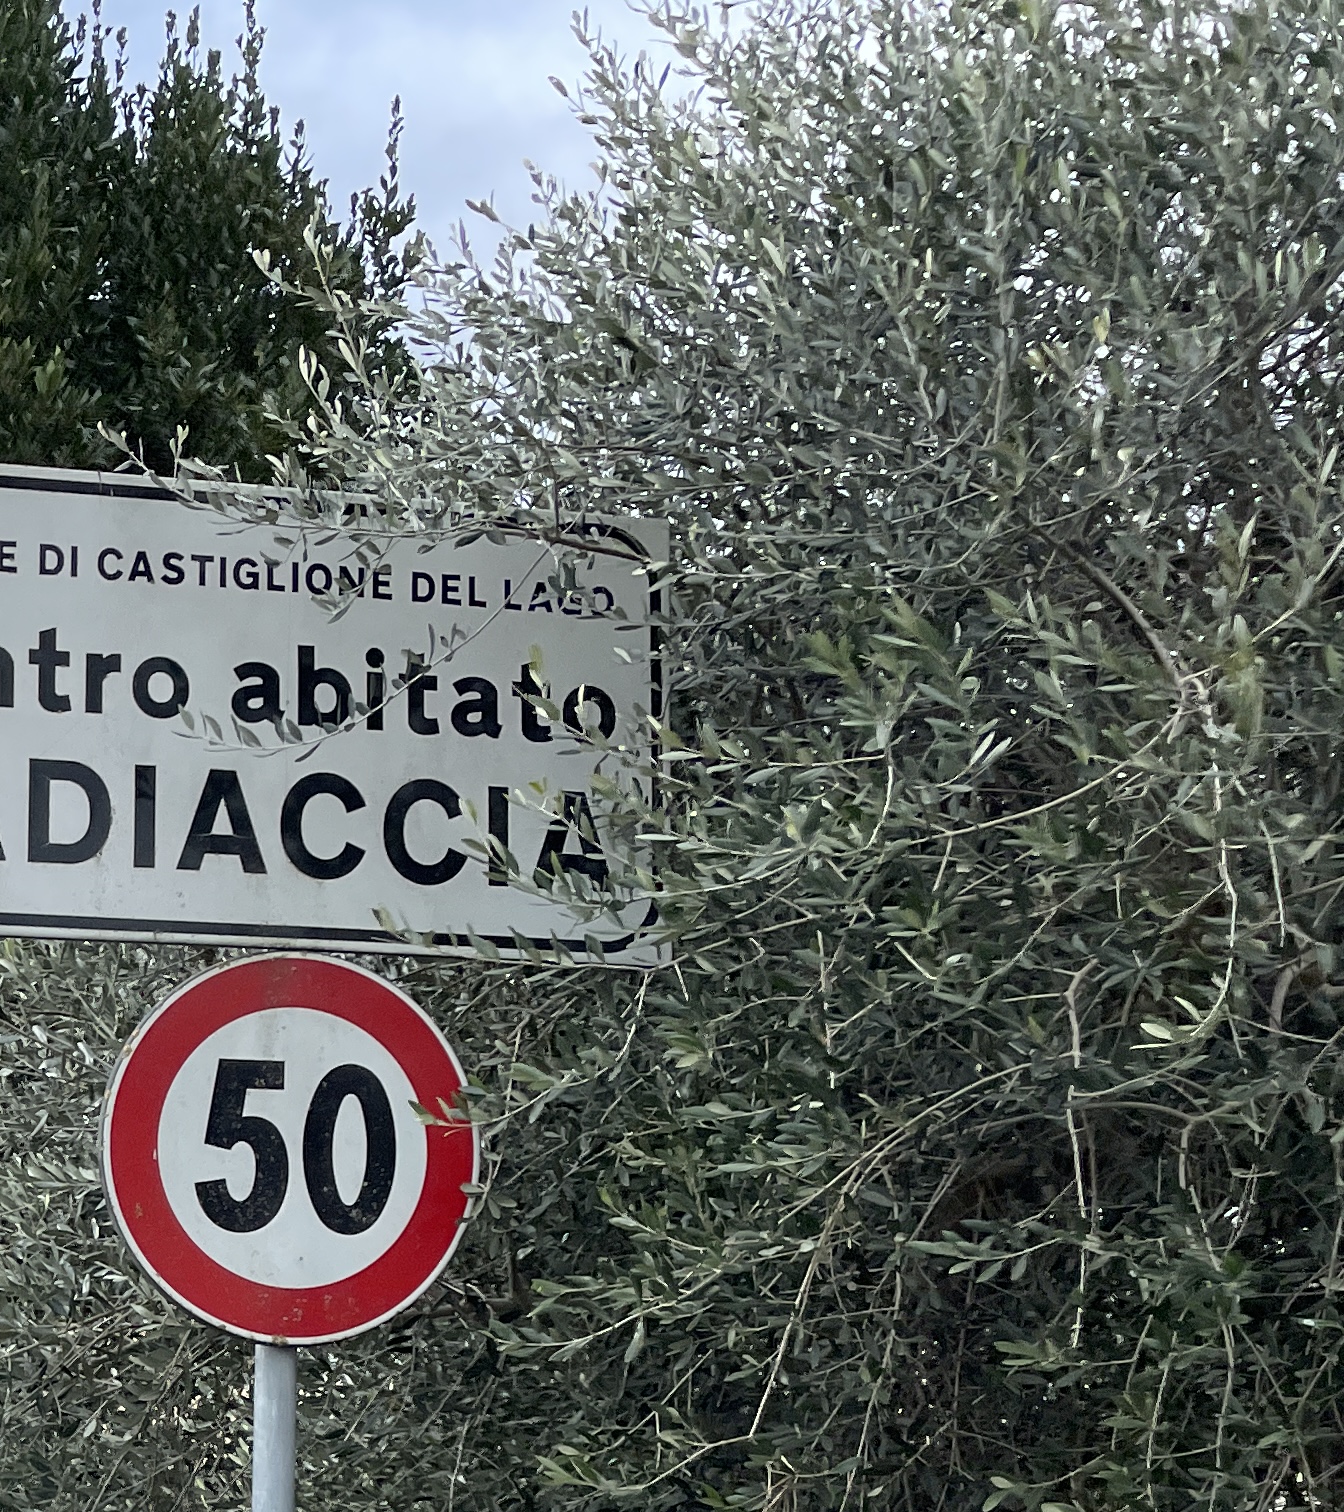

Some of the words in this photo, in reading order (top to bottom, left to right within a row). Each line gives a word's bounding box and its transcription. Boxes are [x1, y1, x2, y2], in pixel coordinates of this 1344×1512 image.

[39, 543, 79, 577] DI
[97, 547, 393, 601] CASTIGLIONE
[411, 571, 487, 609] DEL
[231, 645, 616, 744] abitato
[194, 1058, 397, 1236] 50
